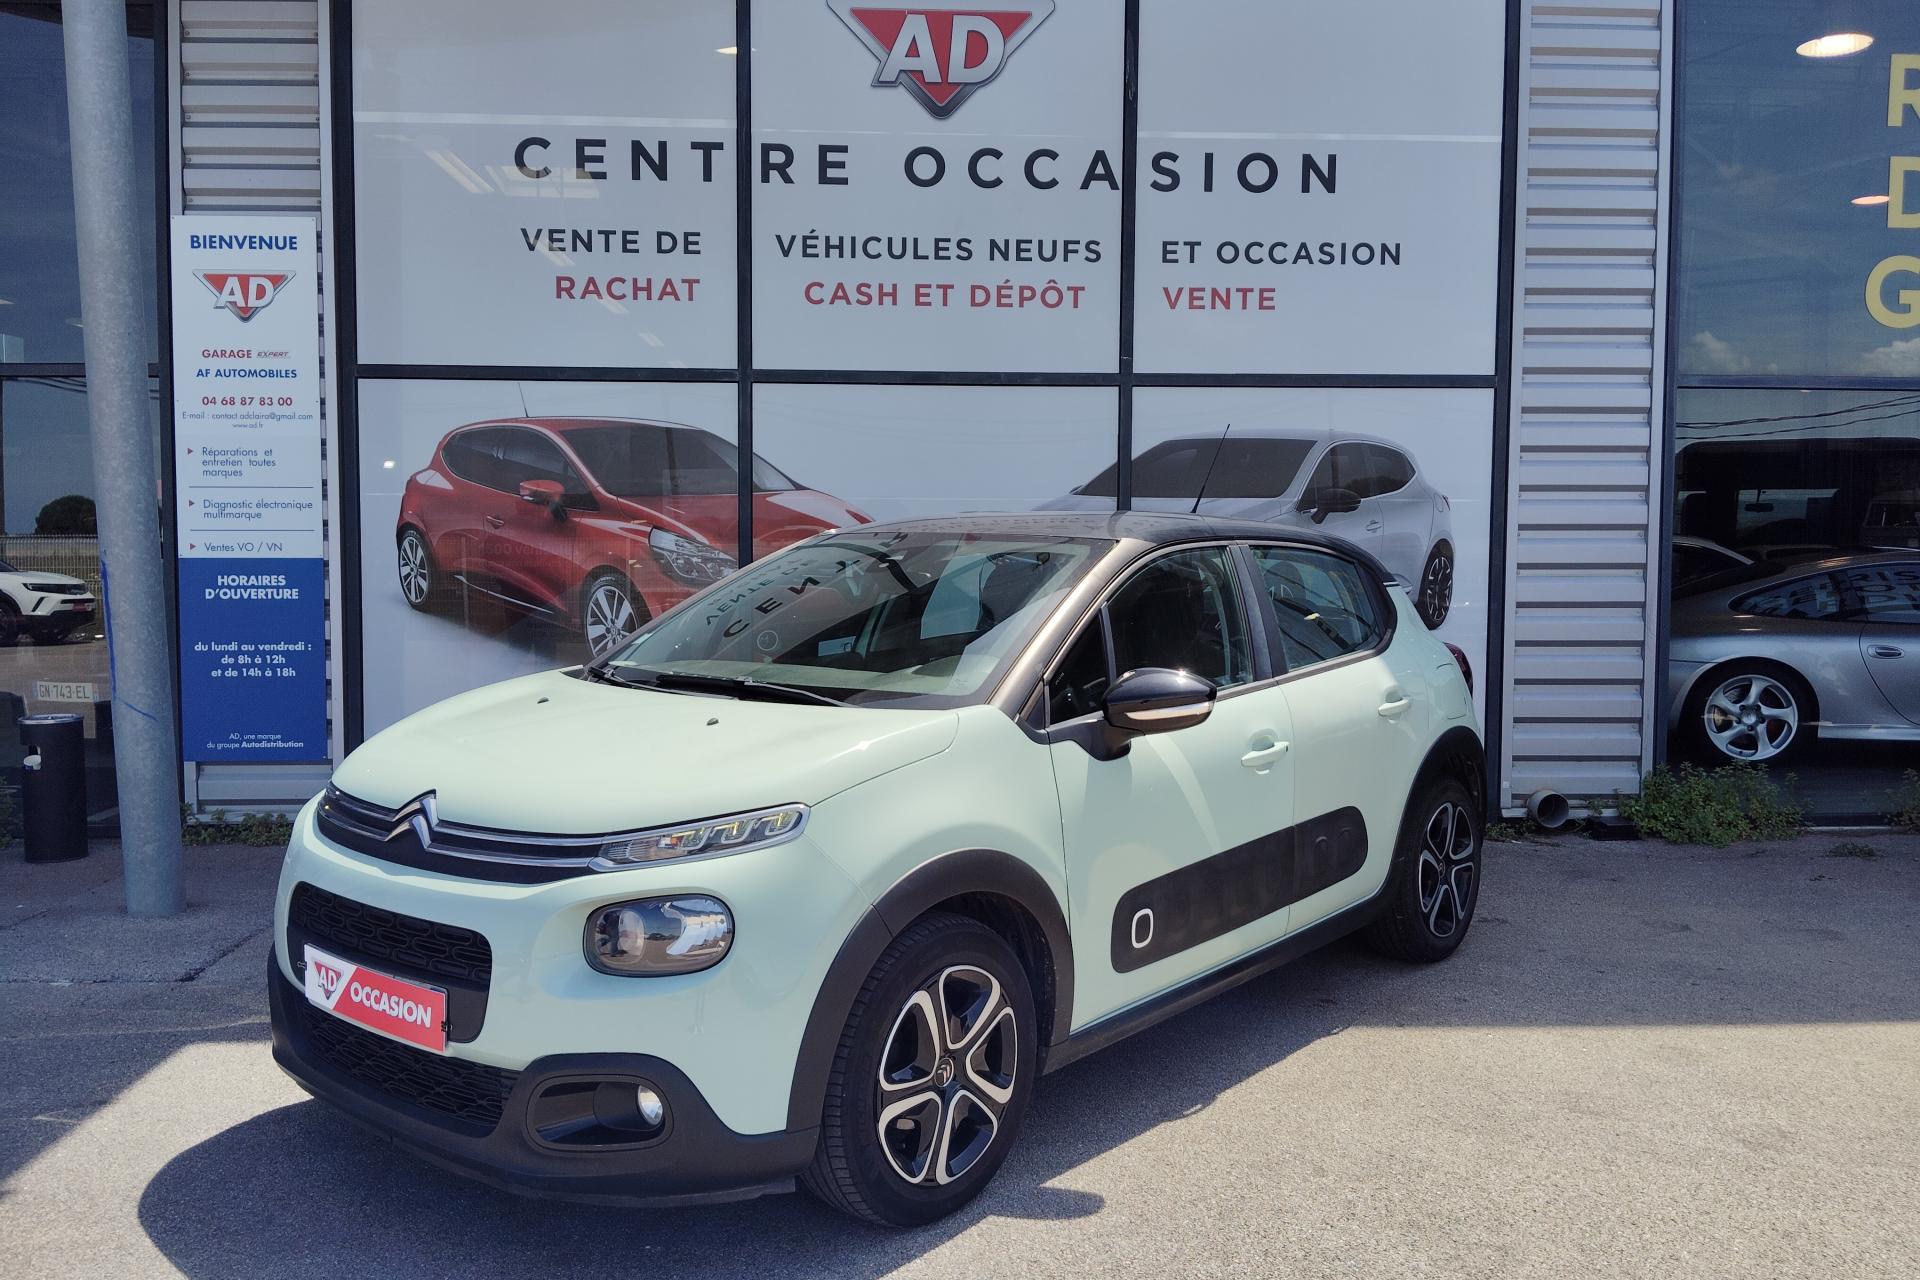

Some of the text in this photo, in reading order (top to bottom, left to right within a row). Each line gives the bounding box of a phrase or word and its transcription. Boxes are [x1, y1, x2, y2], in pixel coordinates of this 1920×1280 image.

[878, 13, 1005, 83] AD
[513, 136, 1337, 194] CENTRE OCCASION
[190, 234, 298, 250] BIENVENUE
[520, 227, 1401, 265] VENTE DE VÉHICULES NEUFS ET OCCASION
[214, 275, 275, 308] AD
[555, 275, 1277, 311] RACHAT CASH ET DÉPÔT VENTE
[201, 349, 253, 359] GARAGE
[196, 368, 298, 379] AF AUTOMOBILES
[201, 396, 293, 407] 04 68 87 83 00
[182, 411, 205, 419] E-mail
[202, 446, 273, 460] Réparations et
[202, 458, 277, 467] entretien toutes
[202, 469, 243, 479] marques
[203, 498, 313, 512] Diagnostic électronique
[203, 509, 262, 522] multimarque
[204, 542, 235, 552] Ventes
[237, 542, 254, 552] VO
[266, 542, 283, 552] VN
[217, 575, 286, 586] HORAIRES
[205, 588, 299, 600] D'OUVERTURE
[194, 641, 209, 651] du
[211, 641, 238, 651] lundi
[241, 643, 255, 651] au
[258, 641, 305, 651] vendredi
[221, 654, 286, 664] de 8h à 12h
[211, 667, 296, 677] et de 14h à 18h
[216, 742, 240, 750] groupe
[241, 740, 304, 748] Autodistribution
[318, 966, 432, 1028] AD OCCASION
